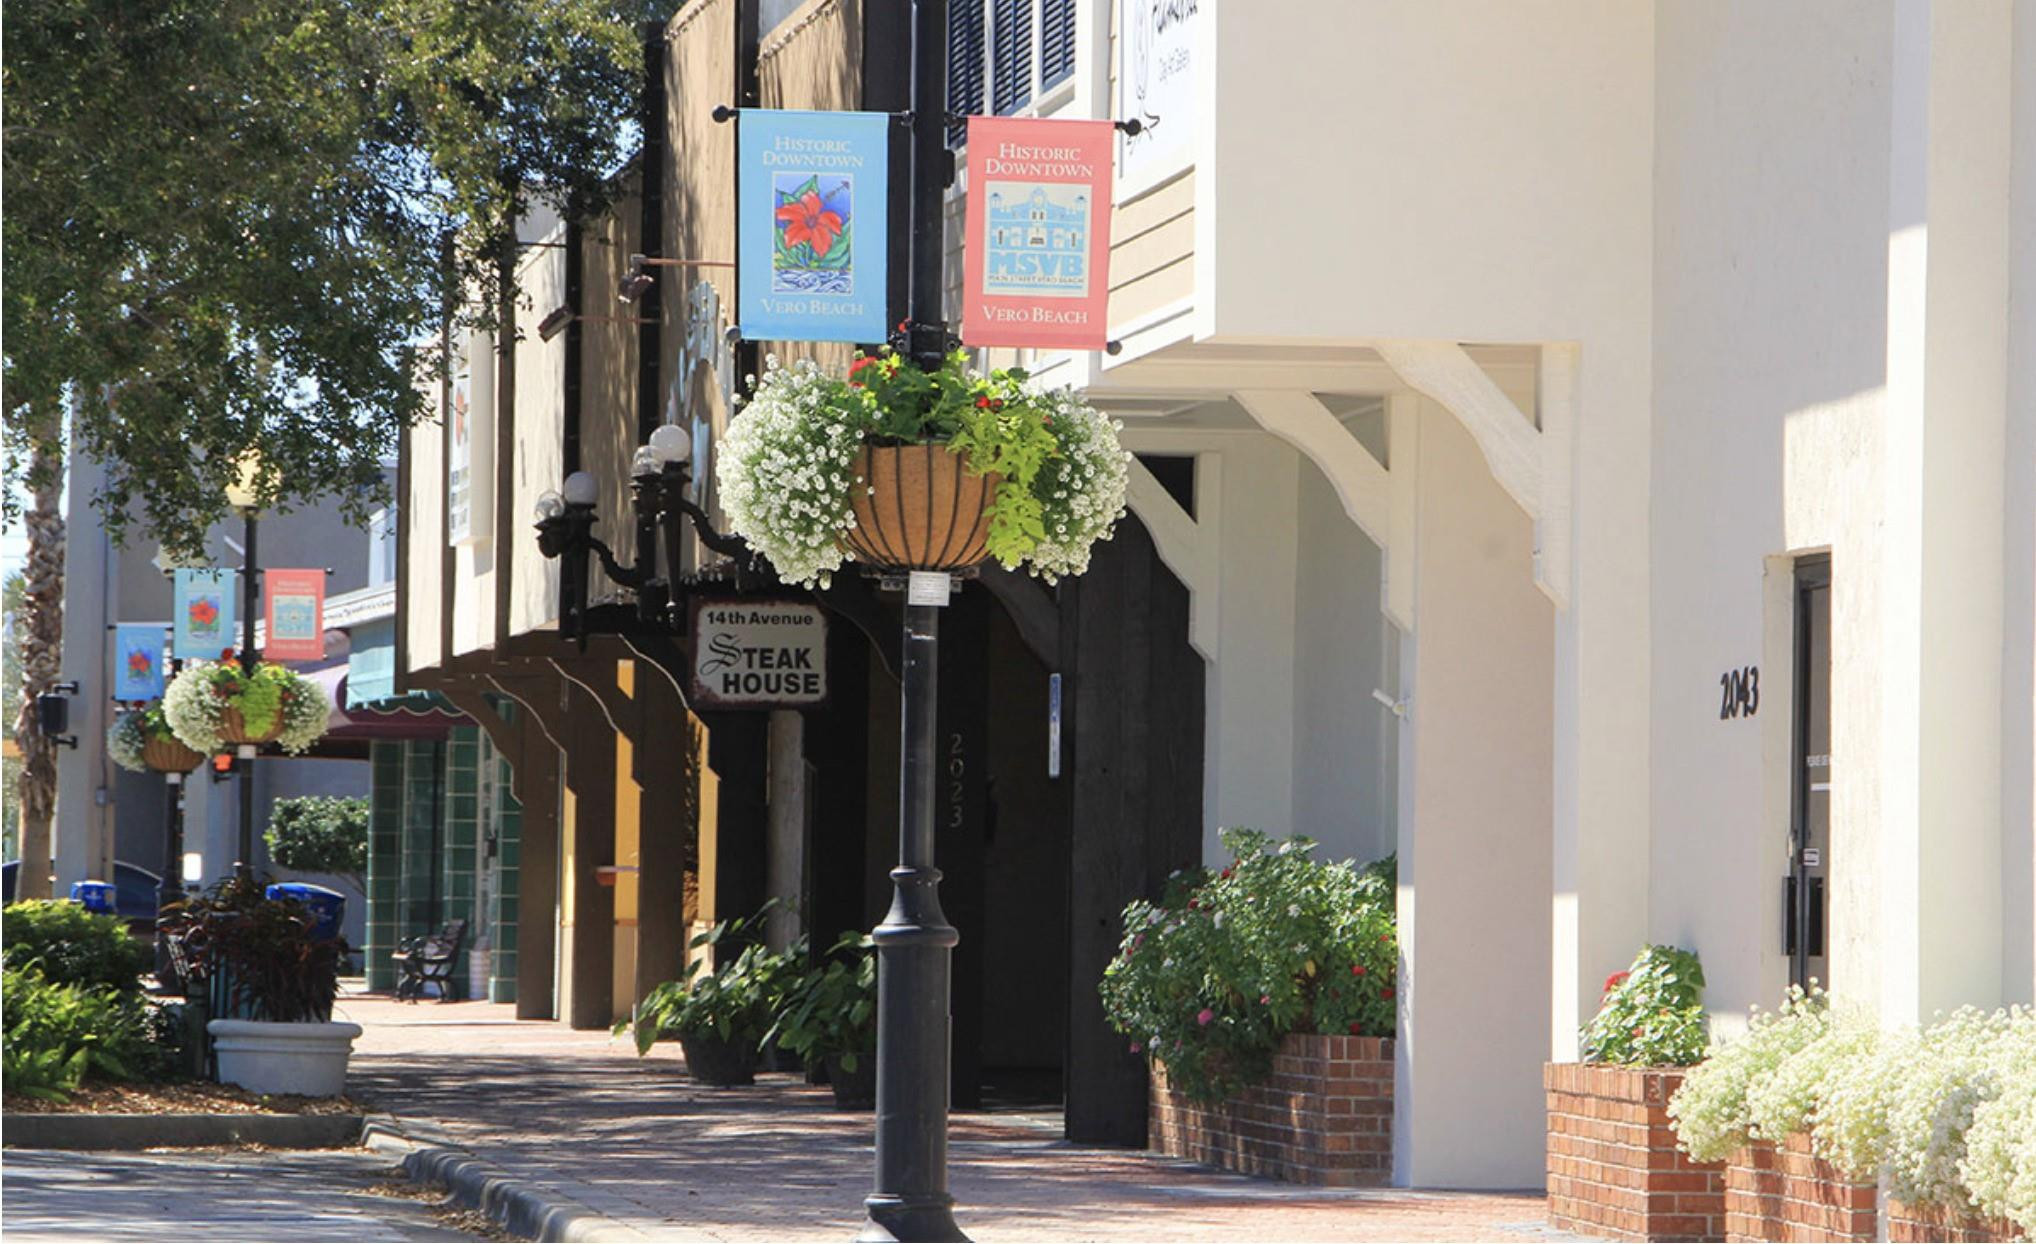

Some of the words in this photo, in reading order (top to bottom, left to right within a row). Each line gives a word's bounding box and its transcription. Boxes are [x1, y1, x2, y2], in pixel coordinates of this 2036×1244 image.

[774, 136, 852, 153] HISTORIC
[999, 142, 1081, 161] HISTORIC
[762, 150, 864, 167] DOWNTOWN
[985, 158, 1093, 177] DOWNTOWN
[989, 252, 1083, 277] MSVB
[760, 298, 807, 314] VERO
[809, 300, 864, 316] BEACH
[982, 304, 1029, 321] VERO
[1032, 307, 1089, 324] BEACH
[707, 611, 746, 625] 14th
[748, 611, 814, 625] Avenue
[699, 632, 812, 676] STEAK
[722, 673, 820, 695] HOUSE
[1720, 666, 1760, 720] 2043
[949, 733, 964, 828] 2023
